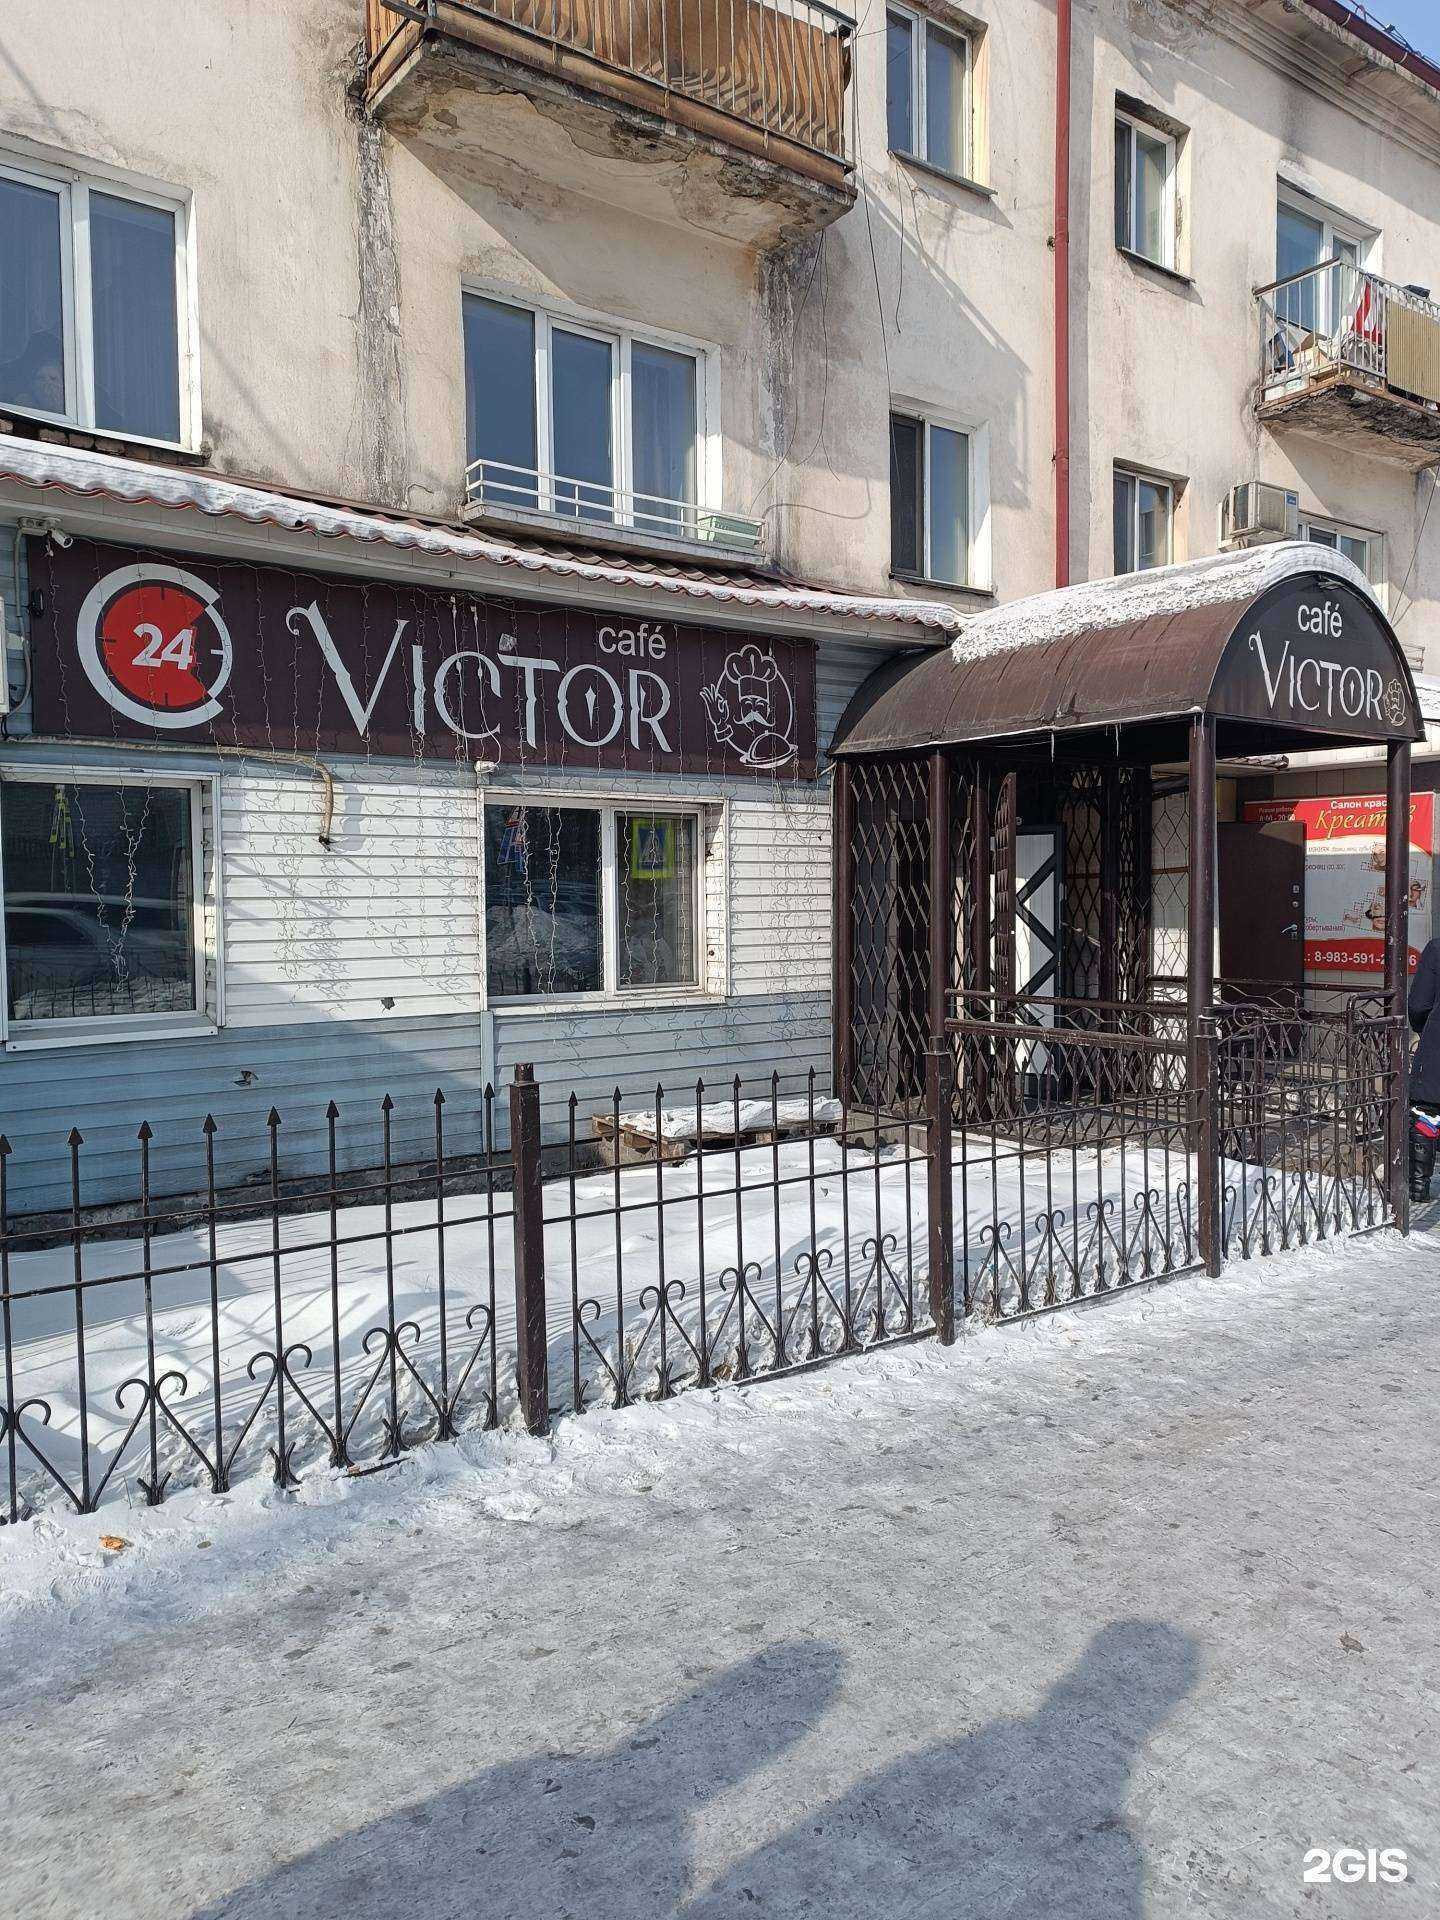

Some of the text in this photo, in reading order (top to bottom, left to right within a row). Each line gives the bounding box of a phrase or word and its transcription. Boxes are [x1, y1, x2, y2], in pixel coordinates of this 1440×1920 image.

[1297, 600, 1344, 638] café
[131, 622, 194, 671] 24
[598, 623, 667, 660] café
[285, 600, 674, 753] VICTOR
[1248, 629, 1384, 721] VICTOR
[1330, 799, 1388, 810] Салон крас
